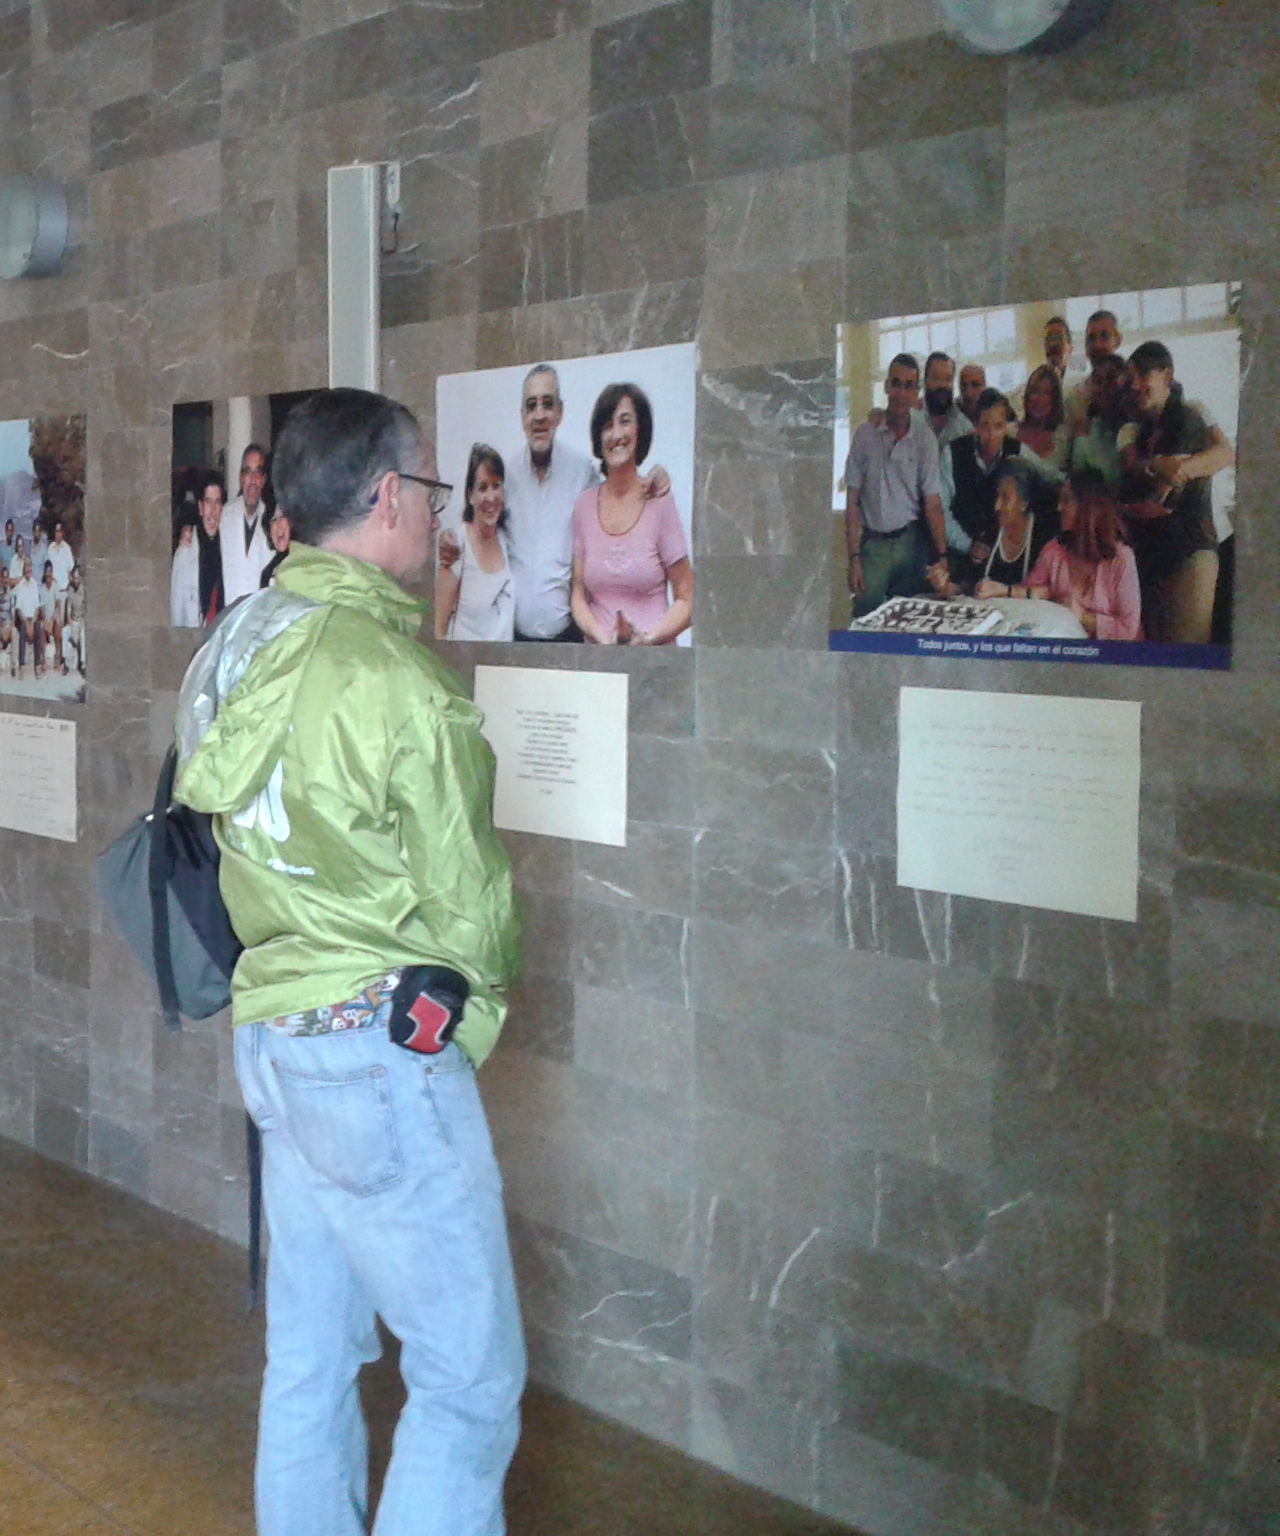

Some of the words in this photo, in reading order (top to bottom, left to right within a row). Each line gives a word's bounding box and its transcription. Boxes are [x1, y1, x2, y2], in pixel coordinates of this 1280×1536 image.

[973, 643, 980, 653] y
[994, 643, 1011, 654] que
[1038, 645, 1051, 654] en
[1052, 644, 1061, 654] el
